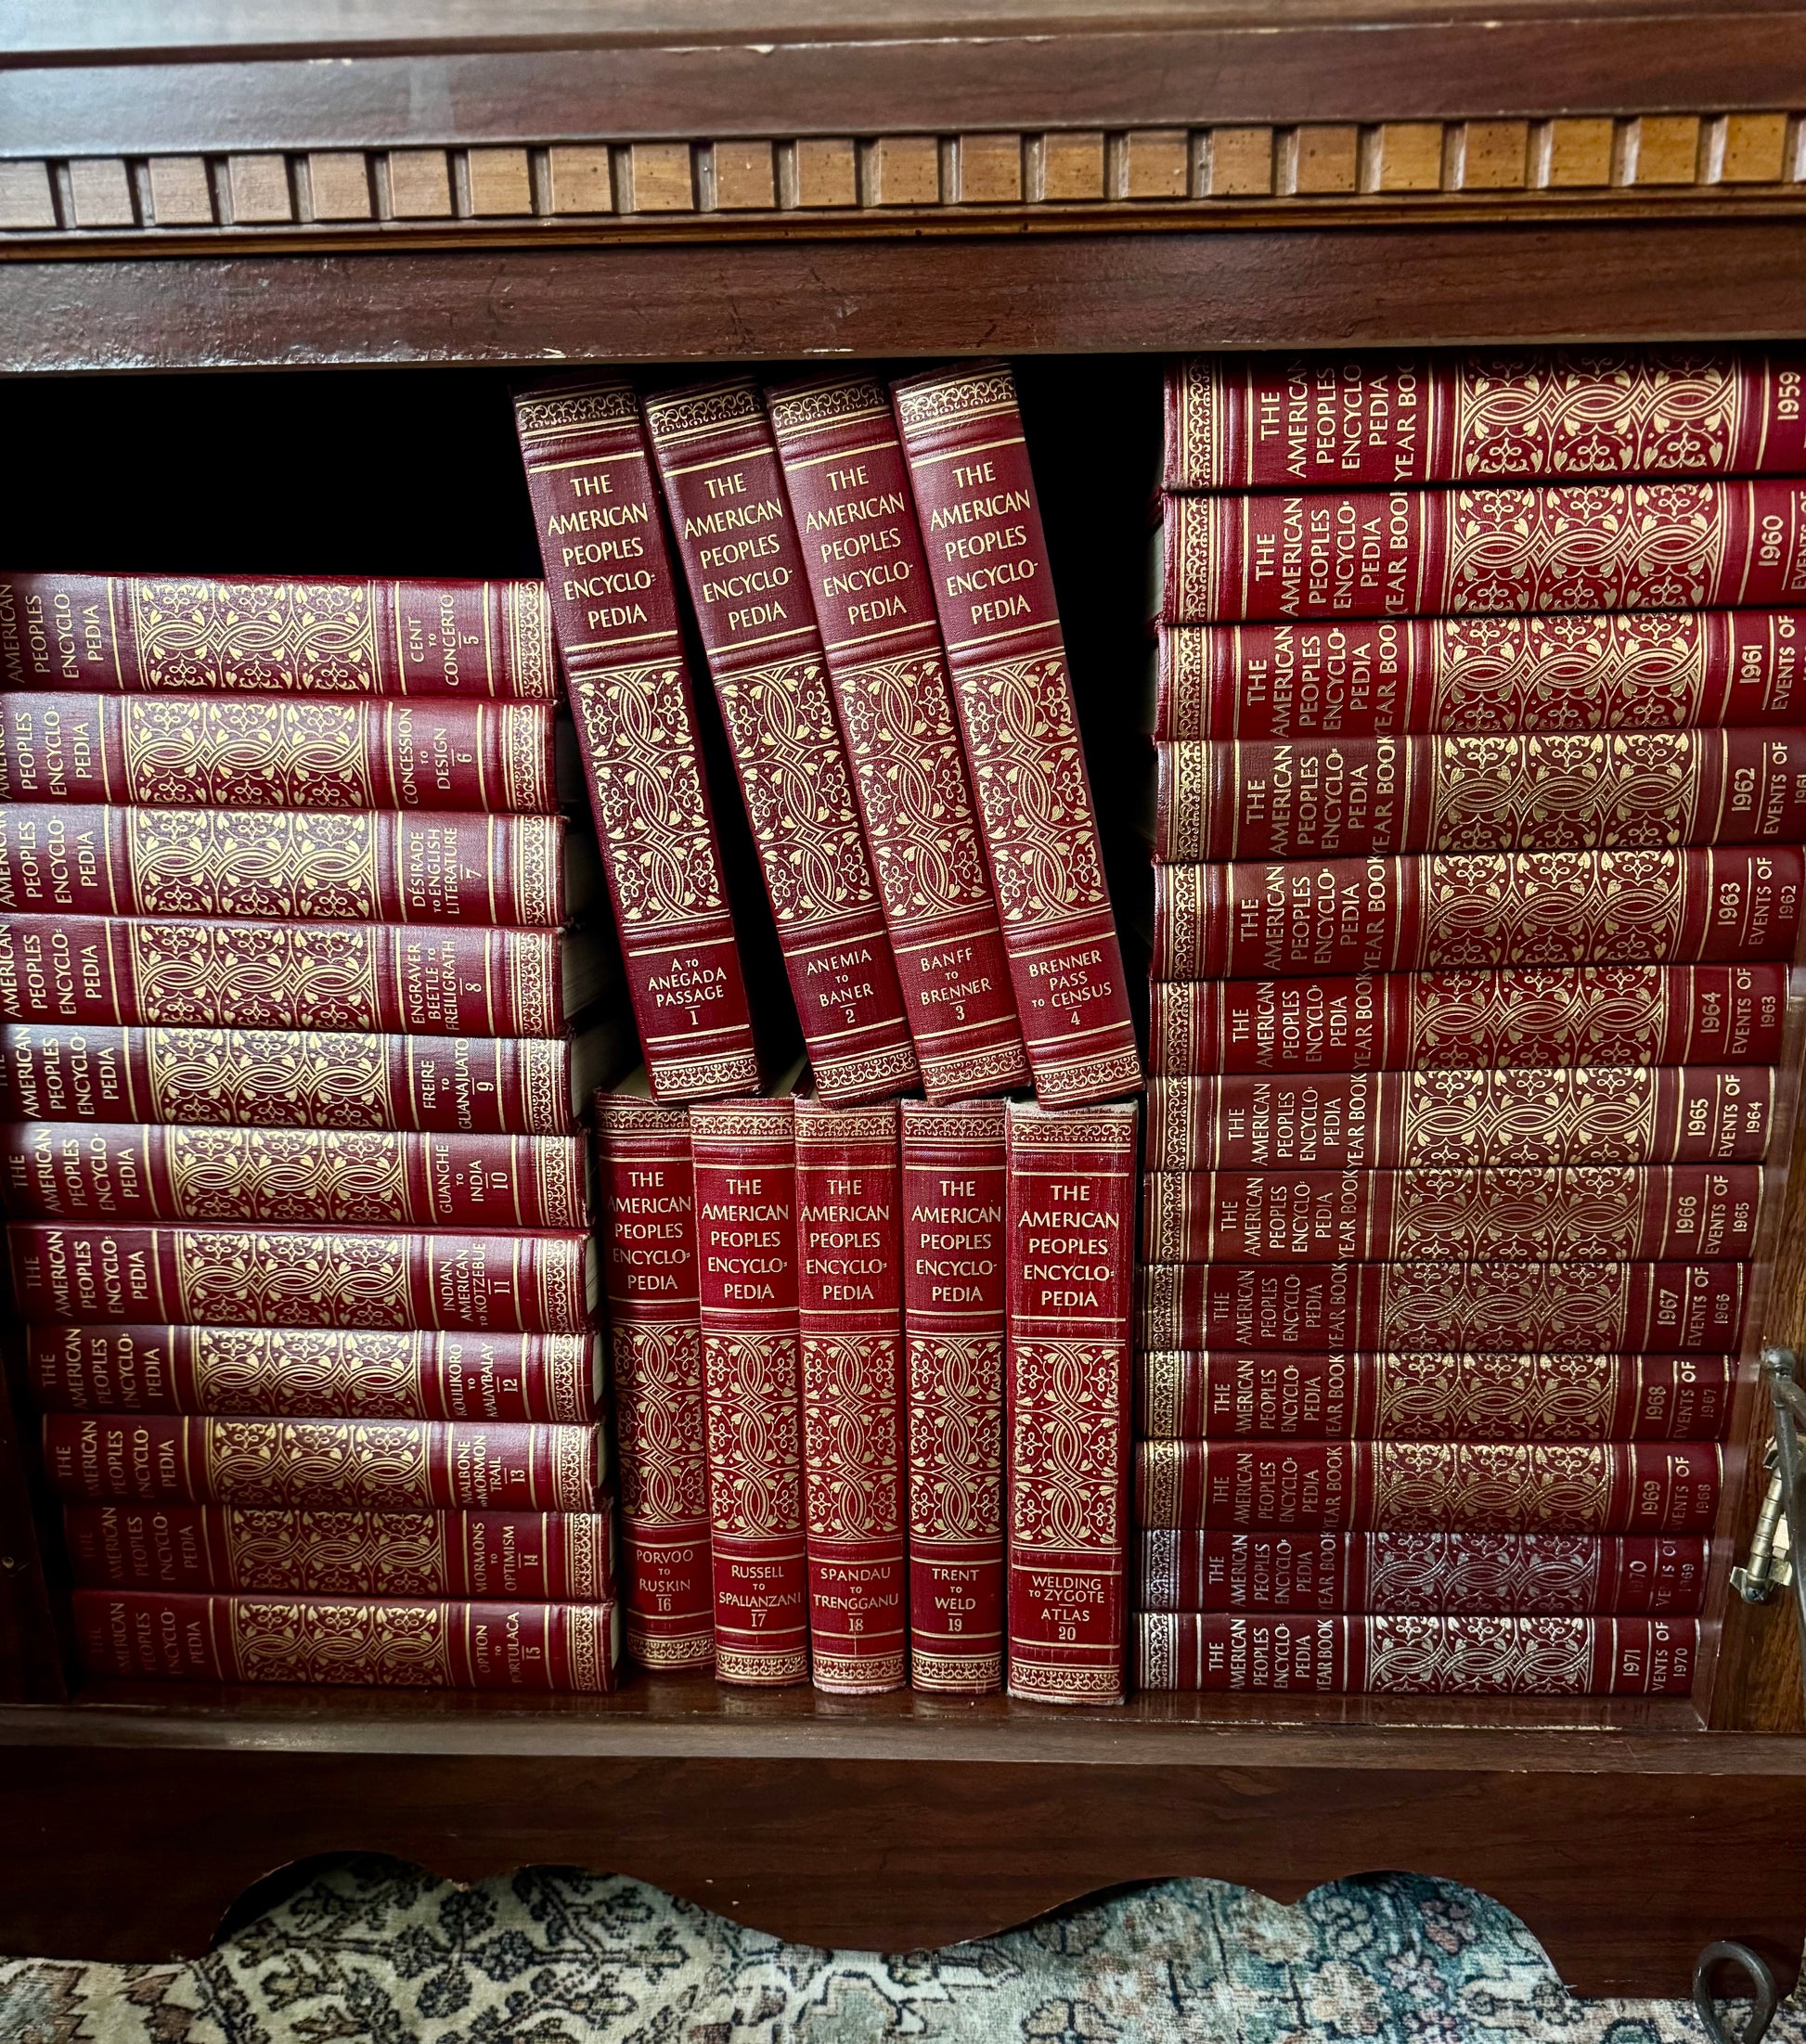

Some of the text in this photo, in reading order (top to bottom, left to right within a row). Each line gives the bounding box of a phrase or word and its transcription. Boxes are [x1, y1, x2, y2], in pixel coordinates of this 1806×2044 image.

[1777, 372, 1800, 419] 1959
[570, 474, 613, 496] THE
[704, 473, 746, 498] THE
[952, 462, 996, 488] THE
[548, 503, 648, 536] AMERICAN
[685, 497, 782, 539] AMERICAN
[928, 490, 1030, 531] AMERICAN
[562, 537, 643, 567] PEOPLES
[700, 534, 780, 569] PEOPLES
[945, 525, 1026, 561] PEOPLES
[1759, 516, 1783, 566] 1960
[588, 604, 647, 629] PEDIA
[729, 601, 787, 630] PEDIA
[971, 595, 1031, 624] PEDIA
[407, 616, 424, 662] CENT
[429, 633, 436, 647] TO
[438, 594, 458, 686] CONCERTO
[463, 636, 479, 644] 5
[1739, 645, 1762, 683] 1961
[398, 709, 418, 803] CONCESSION
[419, 751, 429, 765] TO
[433, 728, 450, 789] DESIGN
[457, 753, 471, 763] 6
[1732, 768, 1754, 811] 1962
[406, 832, 425, 906] DÉSIRADE
[425, 829, 443, 913] TO ENGLISH
[444, 828, 459, 914] LITERATURE
[466, 868, 484, 878] 7
[1718, 882, 1740, 924] 1963
[1748, 857, 1772, 945] EVENTS OF
[1778, 885, 1796, 919] 1962
[25, 935, 47, 1009] PEOPLES
[80, 945, 102, 998] PEDIA
[672, 958, 698, 971] A TO
[807, 949, 872, 975] ANEMIA
[921, 947, 973, 971] BANFF
[1029, 950, 1102, 977] BRENNER
[406, 943, 425, 1023] ENGRAVER
[425, 946, 441, 1019] BEETLE TO
[442, 941, 459, 1030] FREILIGRATH
[466, 983, 481, 992] 8
[649, 967, 727, 991] ANEGADA
[835, 974, 848, 983] TO
[921, 972, 992, 1005] BRENNER
[945, 971, 958, 980] TO
[1050, 971, 1088, 991] PASS
[656, 985, 724, 1009] PASSAGE
[819, 983, 873, 1008] BANER
[1032, 981, 1112, 1008] TO CENSUS
[690, 1010, 698, 1025] 1
[845, 1009, 855, 1023] 2
[956, 1006, 965, 1021] 3
[1071, 1011, 1080, 1025] 4
[1700, 992, 1721, 1033] 1964
[421, 1061, 436, 1108] FREIRE
[442, 1078, 449, 1091] TO
[453, 1037, 472, 1129] GUANAJUATO
[477, 1082, 494, 1091] 9
[1229, 1109, 1244, 1141] THE
[1251, 1084, 1271, 1165] AMERICAN
[1277, 1092, 1294, 1157] PEOPLES
[1323, 1099, 1341, 1145] PEDIA
[1348, 1073, 1367, 1167] YEAR BOOK
[1687, 1099, 1709, 1136] 1965
[1718, 1074, 1740, 1156] EVENTS OF
[1746, 1102, 1762, 1132] 1964
[435, 1142, 453, 1213] GUANCHE
[457, 1174, 464, 1185] TO
[469, 1160, 484, 1202] INDIA
[491, 1173, 508, 1189] 10
[827, 1180, 861, 1195] THE
[1051, 1186, 1090, 1201] THE
[801, 1202, 889, 1223] AMERICAN
[1018, 1211, 1119, 1229] AMERICAN
[1675, 1197, 1696, 1233] 1966
[810, 1232, 880, 1248] PEOPLES
[1029, 1239, 1108, 1254] PEOPLES
[25, 1256, 42, 1288] THE
[46, 1231, 72, 1316] AMERICAN
[74, 1241, 97, 1308] PEOPLES
[128, 1251, 148, 1299] PEDIA
[440, 1257, 455, 1310] INDIAN,
[455, 1249, 473, 1321] AMERICAN
[471, 1243, 491, 1326] TO KOTZEBUE
[494, 1280, 510, 1294] 11
[823, 1284, 874, 1300] PEDIA
[1041, 1291, 1099, 1306] PEDIA
[1658, 1289, 1678, 1325] 1967
[448, 1344, 468, 1416] KOULIKORO
[468, 1378, 475, 1390] TO
[481, 1342, 498, 1418] MALAYBALAY
[503, 1379, 518, 1392] 12
[1645, 1386, 1666, 1420] 1968
[457, 1441, 473, 1503] MALBONE
[473, 1435, 488, 1499] MORMON
[488, 1457, 502, 1492] TRAIL
[510, 1470, 525, 1483] 13
[1641, 1481, 1660, 1514] 1969
[472, 1523, 486, 1592] MORMONS
[503, 1525, 521, 1590] OPTIMISM
[523, 1555, 538, 1565] 14
[637, 1549, 693, 1563] PORVOO
[639, 1578, 690, 1592] RUSKIN
[731, 1565, 784, 1578] RUSSELL
[820, 1567, 890, 1581] SPANDAU
[932, 1568, 979, 1581] TRENT
[1032, 1575, 1101, 1590] WELDING
[658, 1598, 671, 1611] 16
[719, 1592, 800, 1607] SPALLANZANI
[813, 1594, 898, 1610] TRENGGANU
[935, 1597, 975, 1609] WELD
[1044, 1589, 1104, 1603] ZYGOTE
[751, 1613, 768, 1627] 17
[849, 1618, 863, 1632] 18
[948, 1618, 961, 1631] 19
[1041, 1609, 1090, 1624] ATLAS
[507, 1611, 524, 1683] PORTULACA
[1059, 1626, 1076, 1640] 20
[476, 1626, 490, 1672] OPTION
[525, 1648, 540, 1659] 15
[1209, 1642, 1223, 1671] THE
[1231, 1619, 1246, 1689] AMERICAN
[1253, 1627, 1269, 1685] PEOPLES
[1296, 1635, 1310, 1678] PEDIA
[1623, 1650, 1641, 1676] 1971
[1673, 1648, 1687, 1677] 1970
